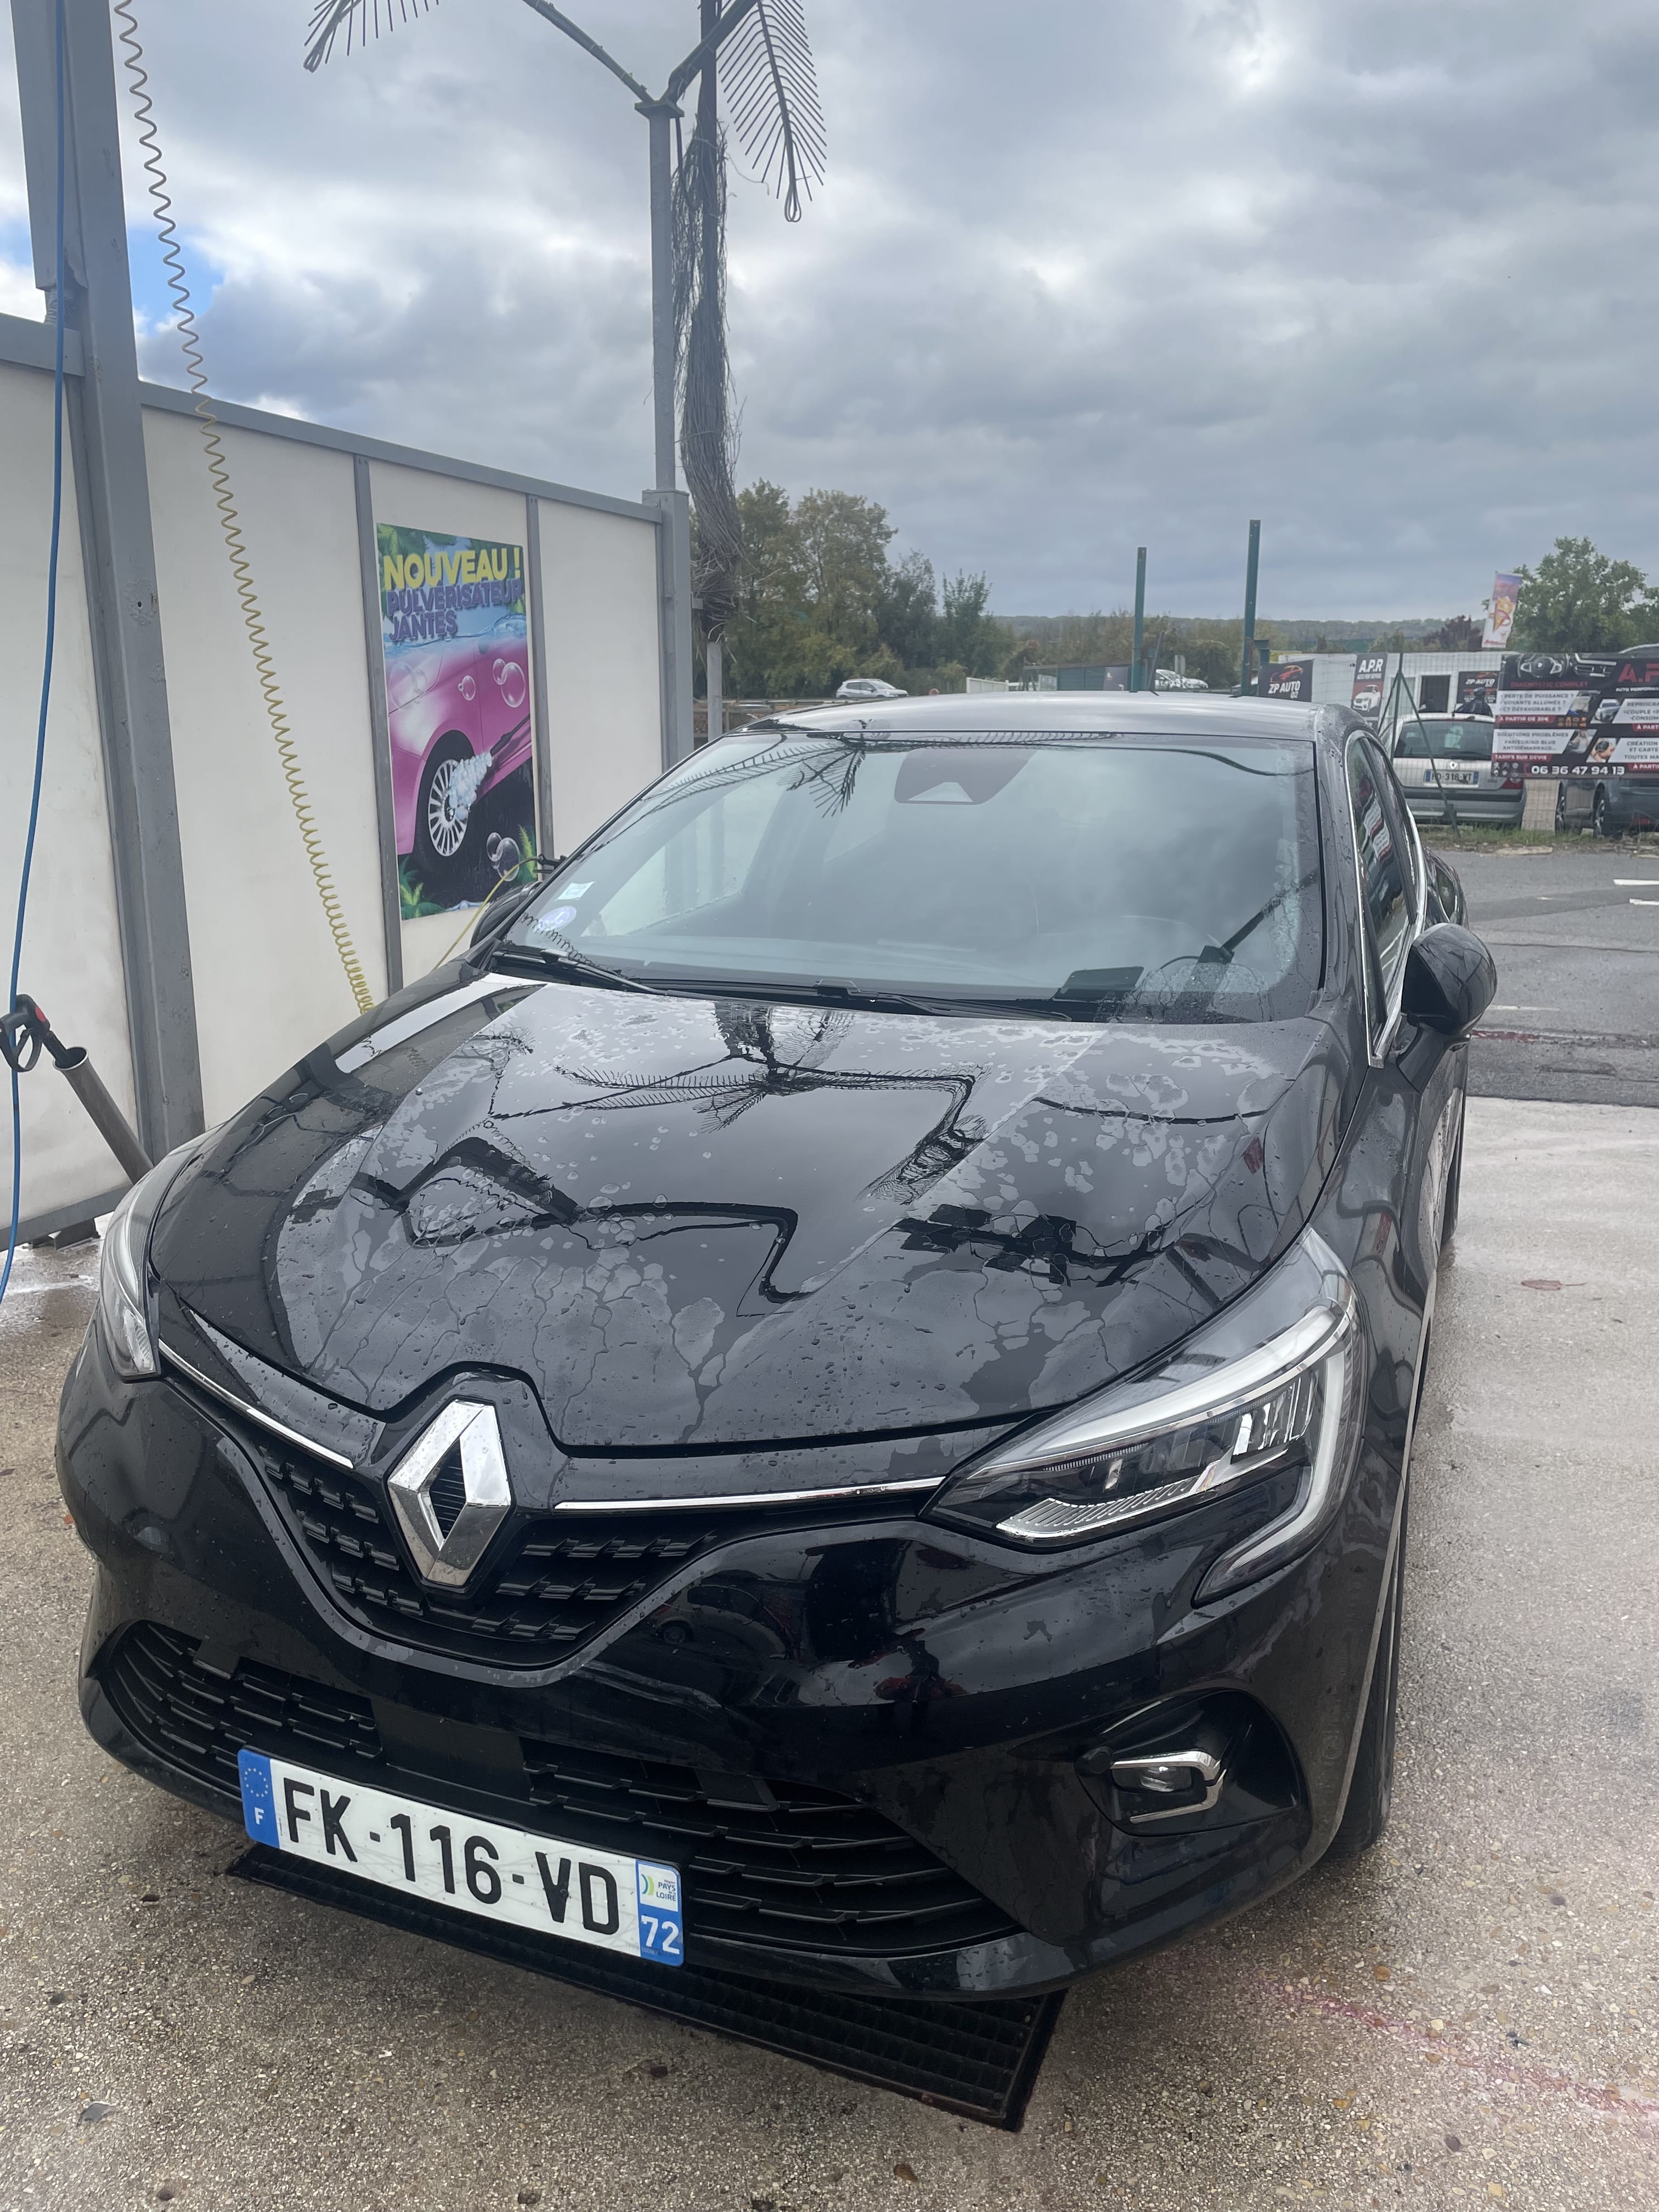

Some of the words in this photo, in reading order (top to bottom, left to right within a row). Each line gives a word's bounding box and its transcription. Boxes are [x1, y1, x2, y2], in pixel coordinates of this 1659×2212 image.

[383, 548, 507, 591] NOUVEAU
[514, 548, 521, 579] !
[386, 579, 524, 616] PULVÉRISATEUR
[389, 610, 458, 641] JANTES
[1358, 658, 1384, 673] A.P.R
[1268, 683, 1280, 694] ZP
[1279, 680, 1301, 693] AUTO
[1290, 691, 1299, 699] 02
[1531, 765, 1549, 775] 06
[1551, 765, 1569, 775] 36
[1571, 766, 1588, 775] 47
[1591, 766, 1609, 775] 94
[1612, 766, 1625, 776] 13
[254, 1807, 264, 1825] F
[283, 1777, 620, 1936] FK-116-VD
[658, 1882, 676, 1891] PAYS
[656, 1891, 676, 1902] LOIRE
[641, 1914, 680, 1955] 72
